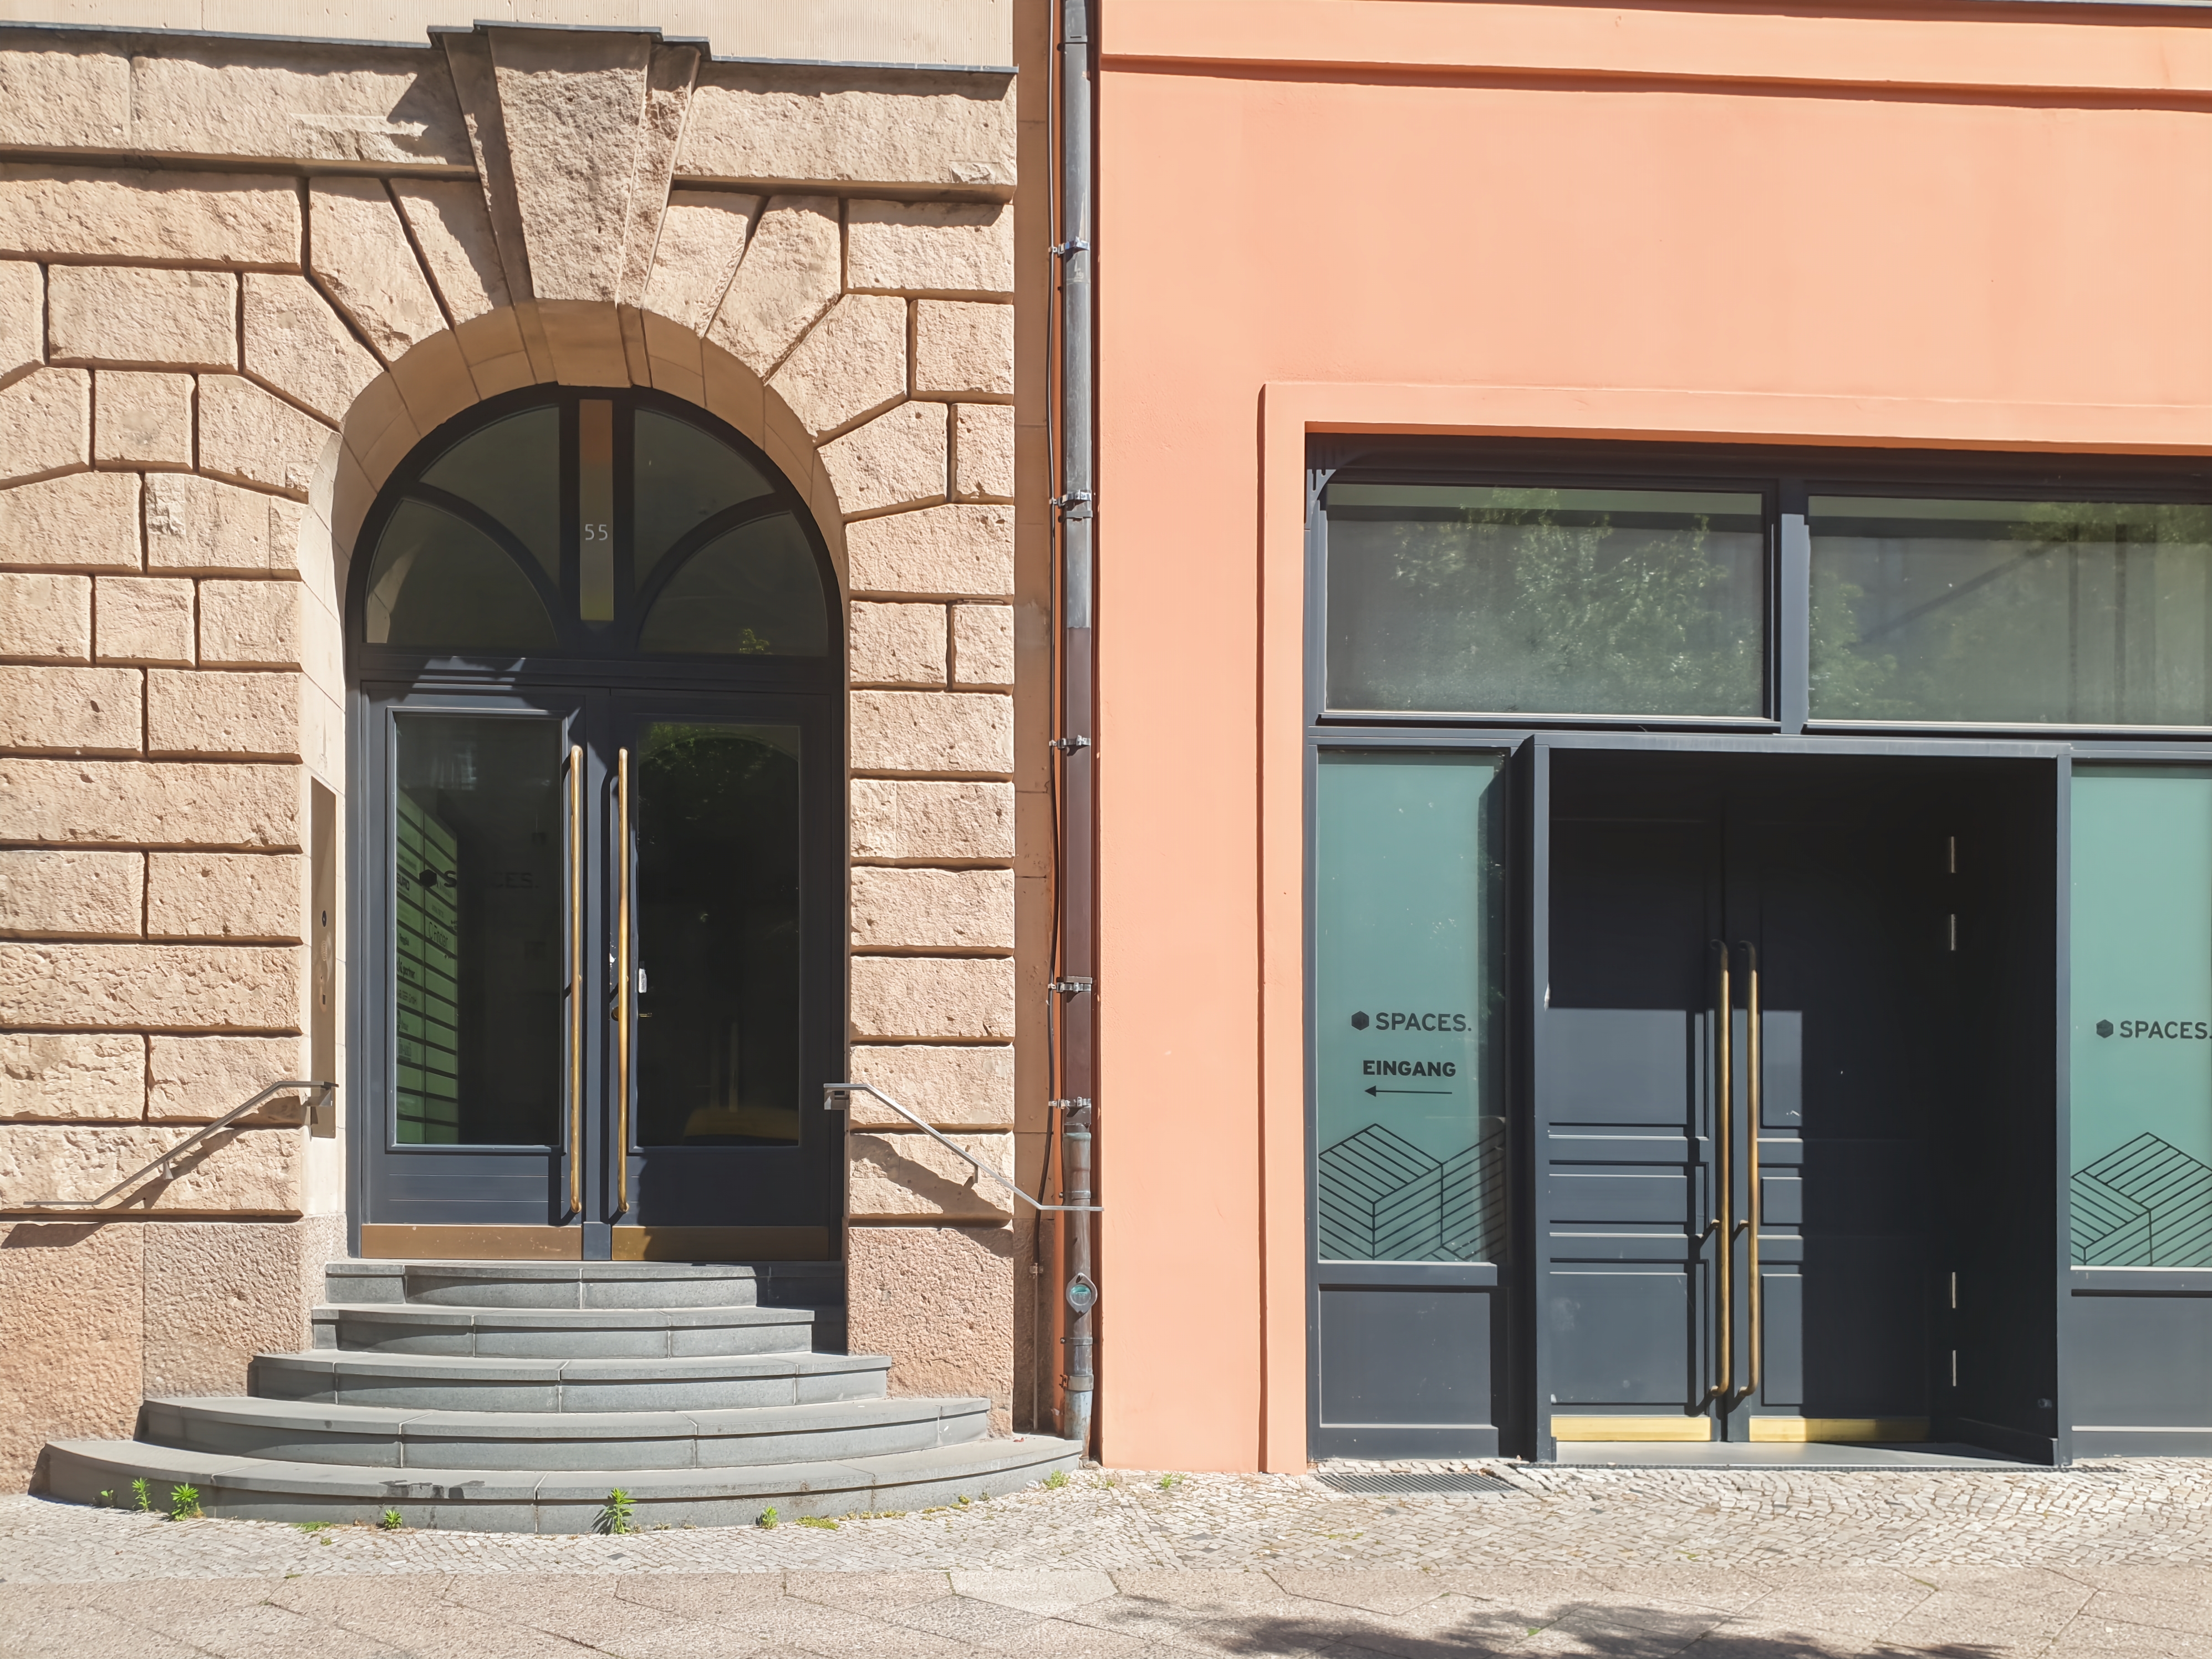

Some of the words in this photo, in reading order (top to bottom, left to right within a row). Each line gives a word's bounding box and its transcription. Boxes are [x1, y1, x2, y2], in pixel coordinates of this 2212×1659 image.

[585, 524, 608, 541] 55
[444, 870, 539, 889] SCES.
[1375, 1012, 1472, 1032] SPACES.
[1363, 1060, 1456, 1077] EINGANG
